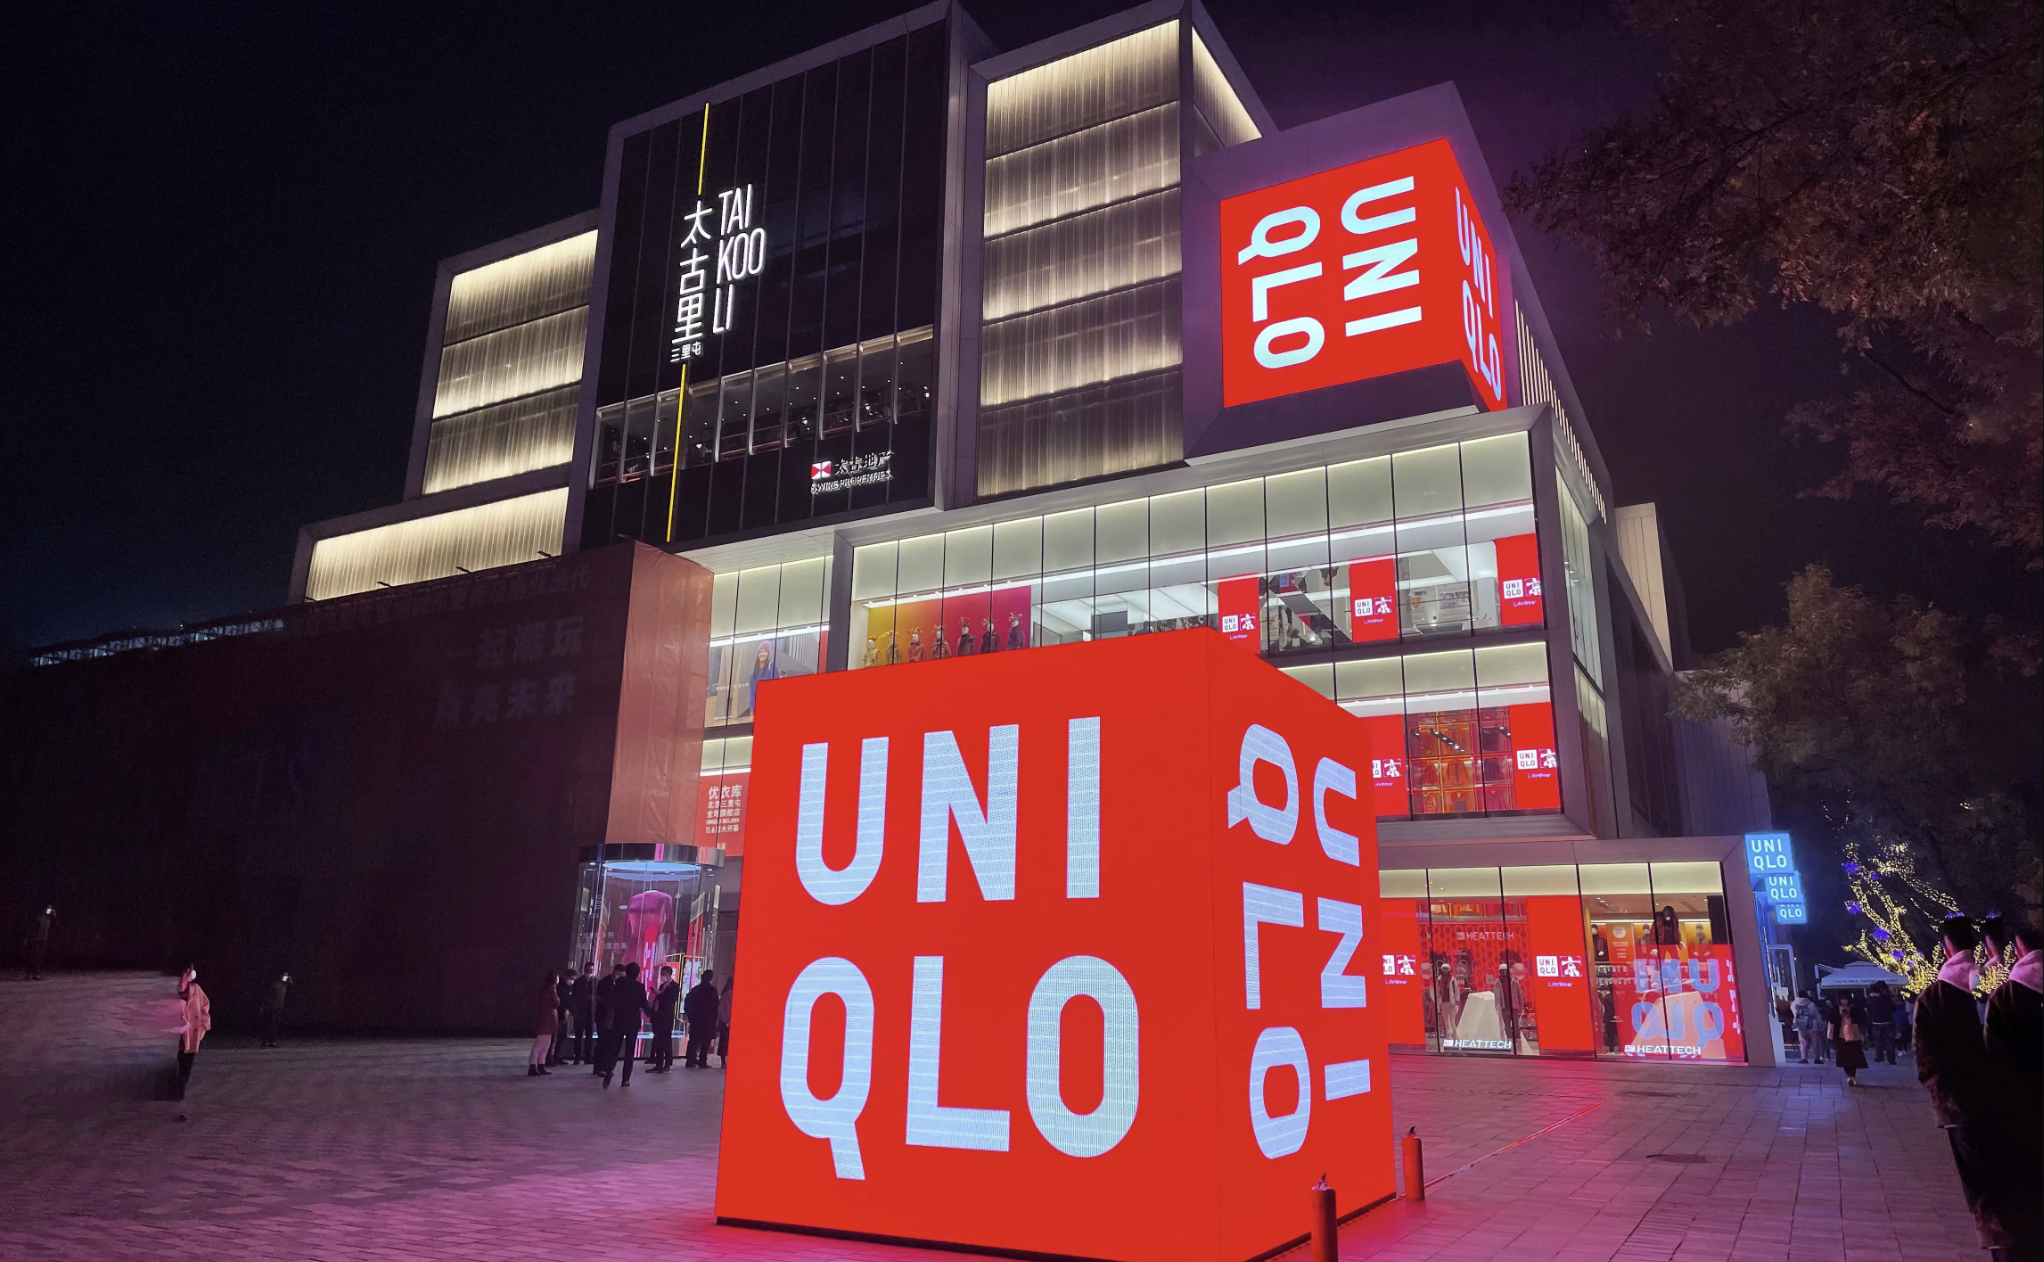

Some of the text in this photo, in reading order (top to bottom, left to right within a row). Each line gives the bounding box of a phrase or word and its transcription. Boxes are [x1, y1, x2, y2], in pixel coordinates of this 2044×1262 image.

[718, 184, 753, 236] TAI
[672, 200, 713, 344] 太古里
[716, 227, 766, 285] KOO
[1341, 176, 1422, 337] UNI
[1455, 186, 1494, 320] UNI
[712, 283, 735, 334] LI
[1238, 206, 1325, 369] QLO
[670, 341, 702, 363] 三里屯
[1462, 279, 1502, 401] QLO
[708, 785, 743, 800] 优衣库
[796, 717, 1100, 905] UNI
[1751, 839, 1783, 853] UNI
[1753, 855, 1788, 871] QLO
[1768, 876, 1794, 886] UNI
[1770, 888, 1798, 901] QLO
[1313, 757, 1371, 1101] UNI
[1780, 908, 1803, 919] QLO
[1228, 724, 1310, 1159] QLO
[1540, 967, 1556, 975] QLO
[780, 956, 1139, 1180] QLO
[1455, 1039, 1512, 1049] HEATTECH
[1637, 1045, 1701, 1055] HEATTECH
